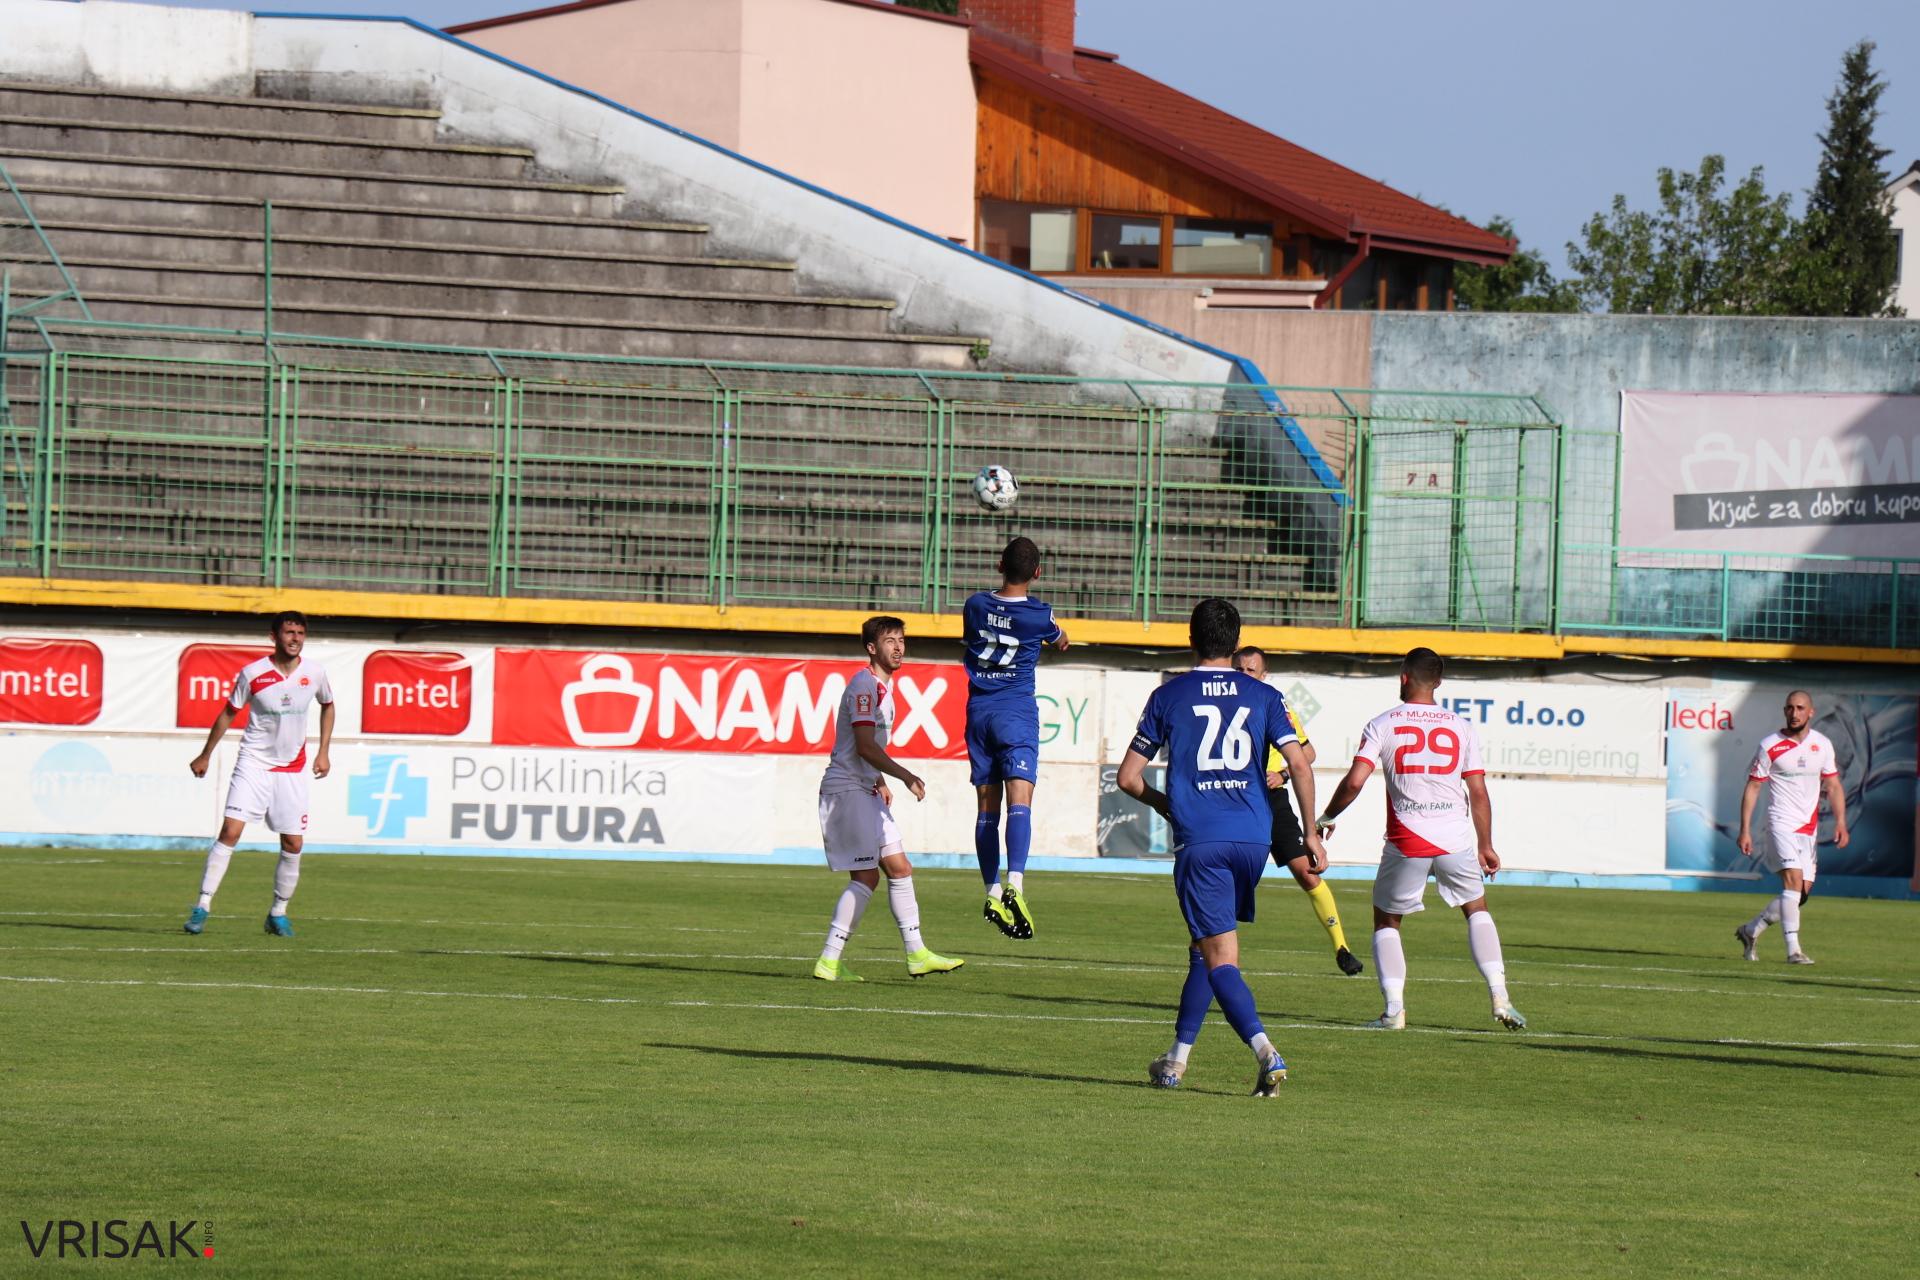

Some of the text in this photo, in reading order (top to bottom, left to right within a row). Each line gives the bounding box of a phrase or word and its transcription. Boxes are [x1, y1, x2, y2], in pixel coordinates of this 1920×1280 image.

[1755, 434, 1920, 490] NAM
[1768, 500, 1802, 520] za
[1810, 491, 1866, 518] dobru
[0, 664, 90, 698] m:tel
[373, 675, 460, 709] m:tel
[1202, 681, 1238, 697] MUSA
[658, 666, 949, 750] NAMX
[1035, 694, 1088, 745] GY
[1390, 711, 1403, 719] FK
[1406, 710, 1456, 721] MLADOST
[1506, 700, 1585, 727] d.o.o
[1671, 700, 1735, 731] leda
[1191, 704, 1251, 771] 26
[1393, 725, 1460, 775] 29
[1502, 741, 1640, 775] inženjering
[451, 756, 667, 796] Poliklinika
[1405, 801, 1453, 811] MGM FARM
[450, 803, 665, 845] FUTURA
